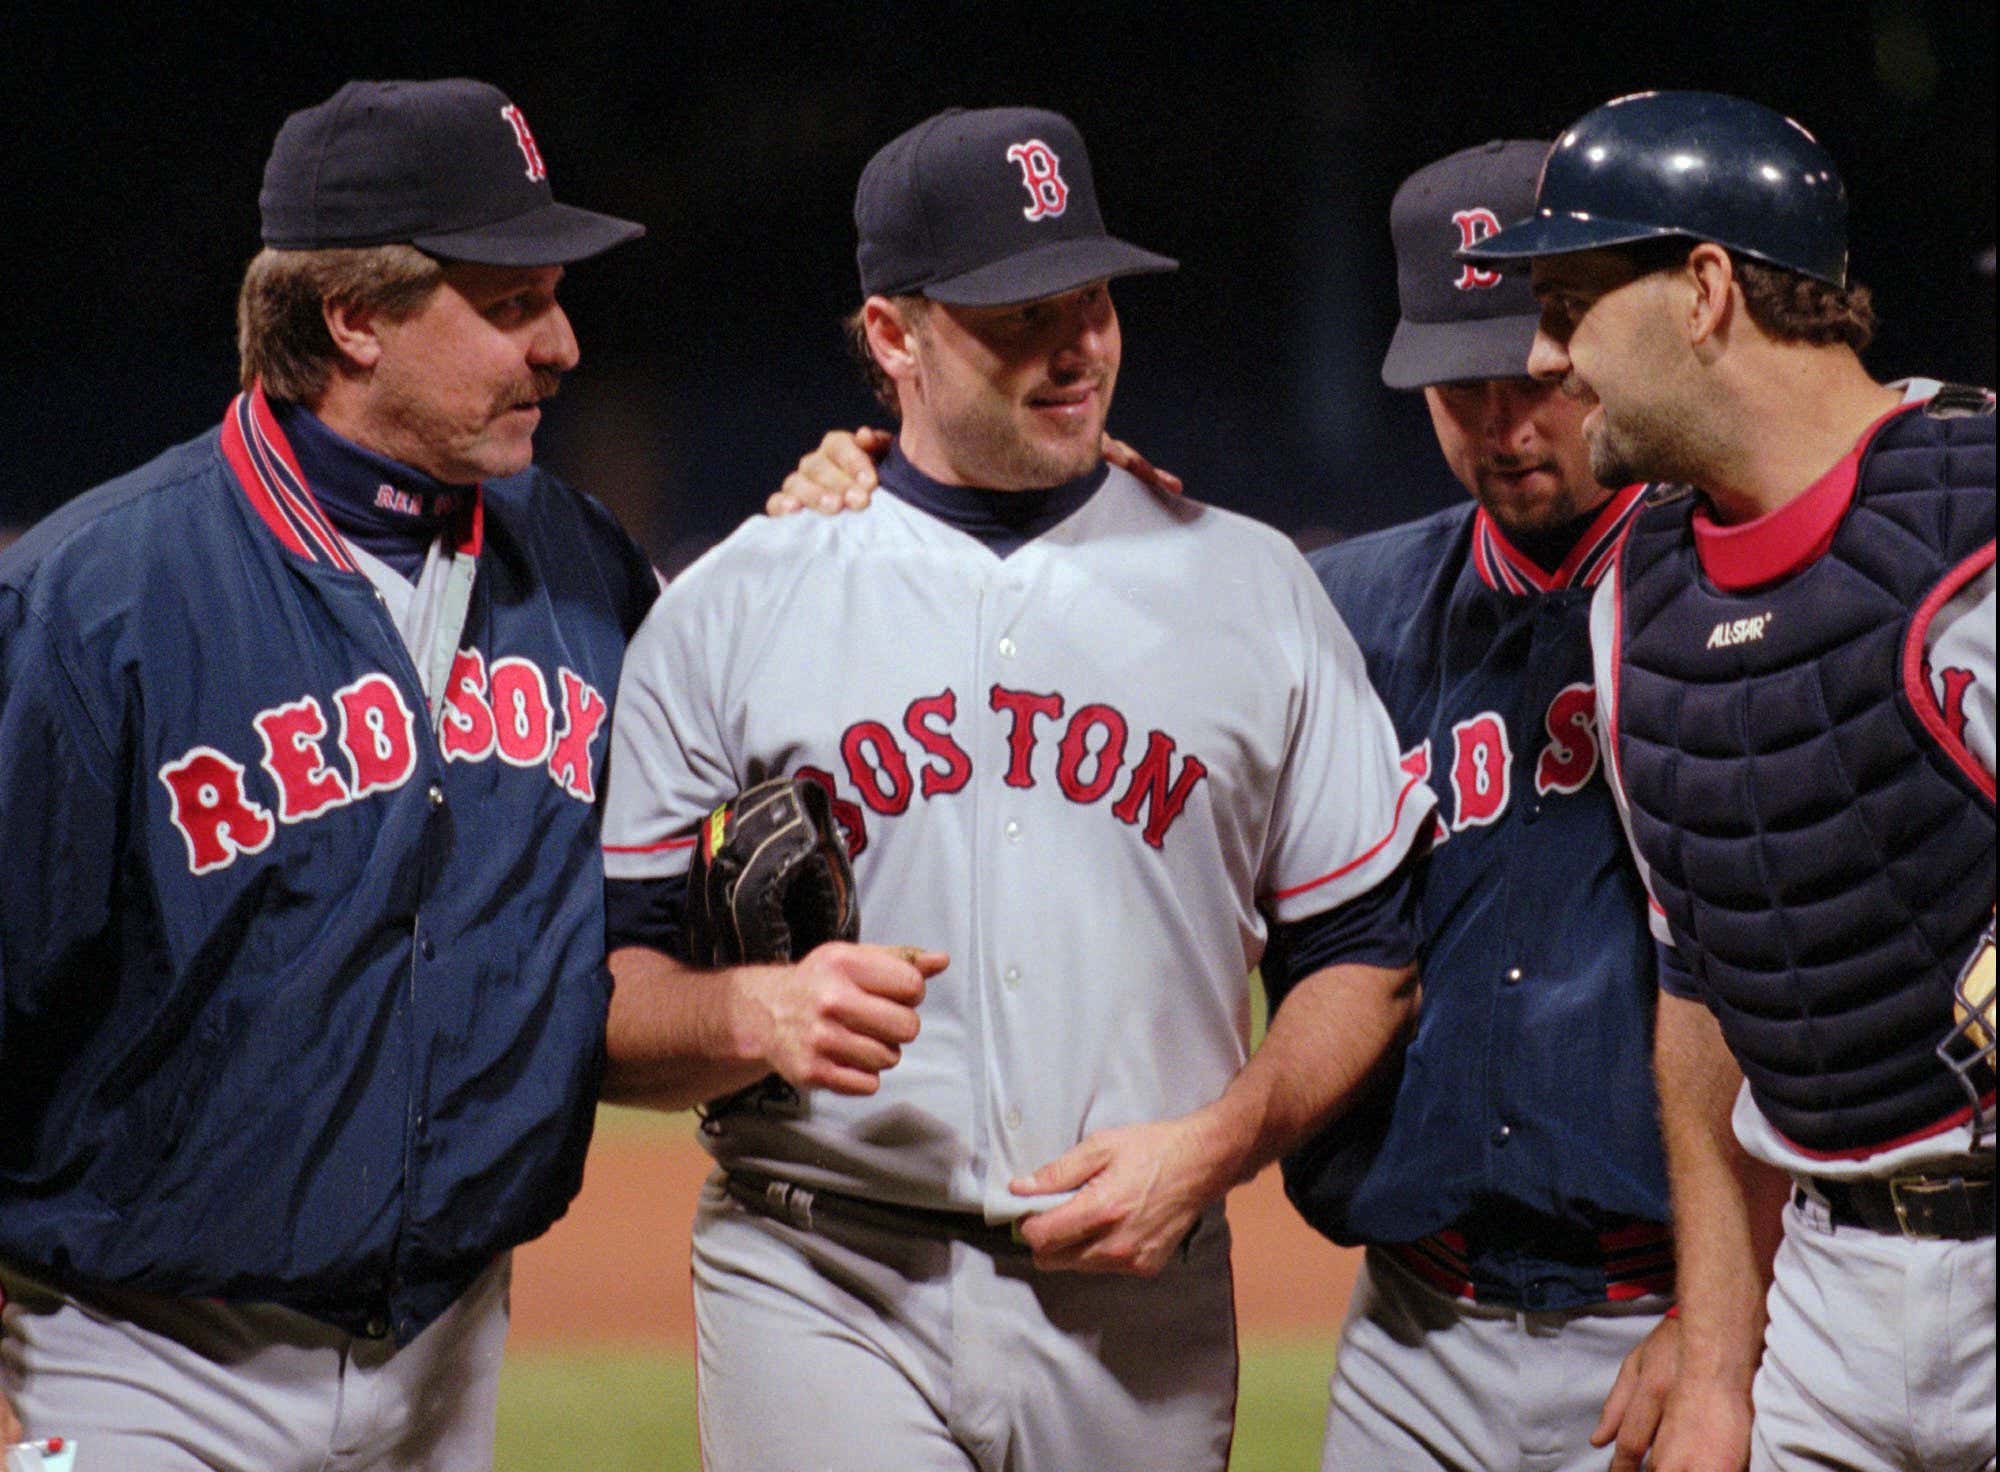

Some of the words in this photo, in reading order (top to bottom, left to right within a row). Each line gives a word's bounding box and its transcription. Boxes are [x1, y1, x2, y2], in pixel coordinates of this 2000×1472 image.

[1006, 139, 1069, 222] B
[158, 672, 418, 875] RED
[438, 645, 607, 803] SOX
